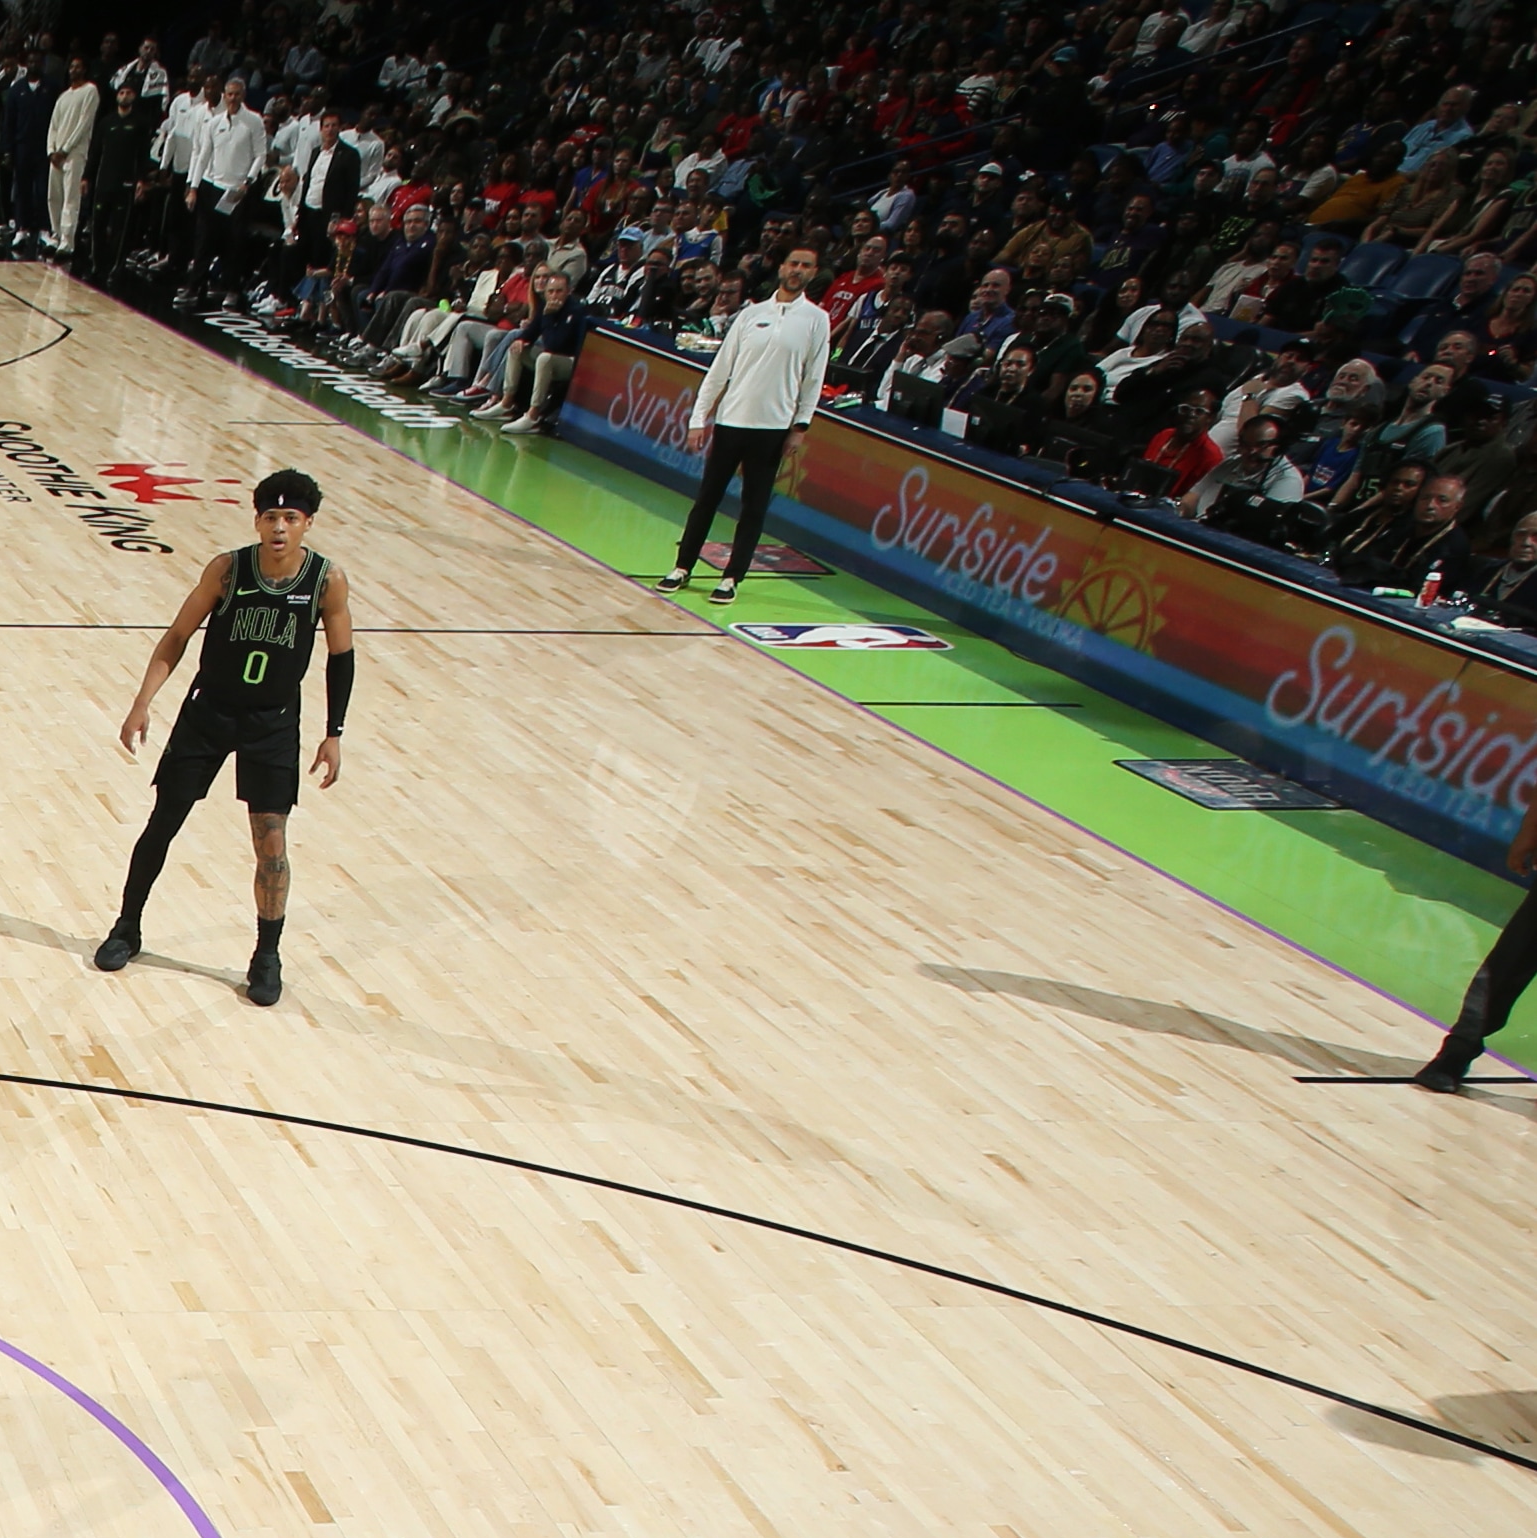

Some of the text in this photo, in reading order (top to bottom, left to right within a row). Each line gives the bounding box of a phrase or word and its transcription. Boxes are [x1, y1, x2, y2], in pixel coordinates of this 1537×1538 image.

[203, 316, 462, 428] Ochsner Health
[608, 360, 715, 456] Surfs
[871, 465, 1059, 603] Surfside
[229, 606, 298, 649] NOLA
[242, 650, 269, 685] 0
